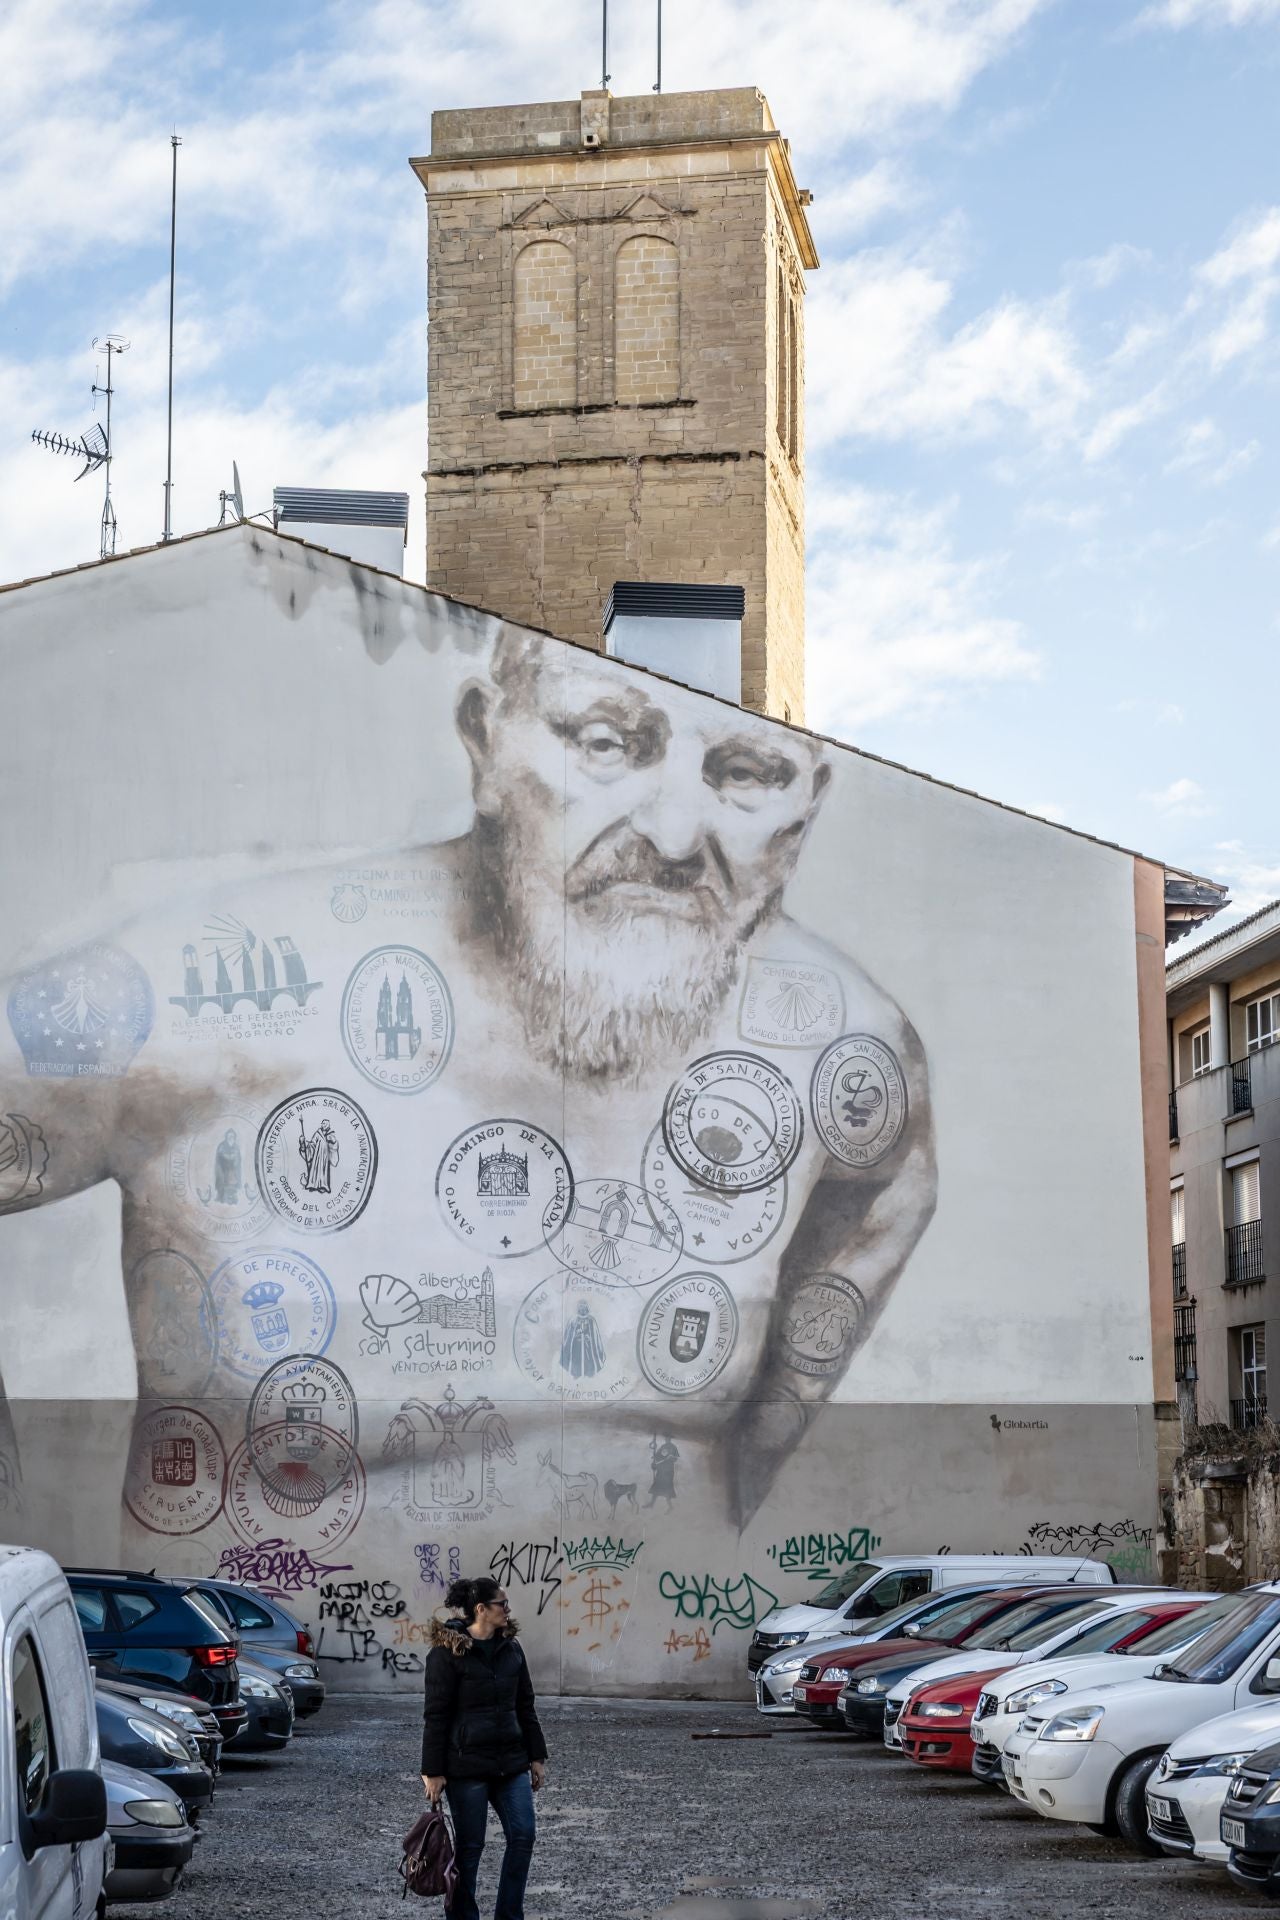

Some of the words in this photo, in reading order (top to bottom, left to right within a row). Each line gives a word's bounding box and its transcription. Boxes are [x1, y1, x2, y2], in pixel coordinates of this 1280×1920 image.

[762, 966, 797, 979] CENTRO
[798, 970, 830, 986] SOCIAL
[350, 981, 368, 1050] CONCATEDRAL
[431, 998, 444, 1041] REDONDA
[747, 1026, 778, 1040] AMIGOS
[835, 1050, 846, 1060] DE
[853, 1044, 870, 1054] SAN
[693, 1071, 709, 1086] DE
[716, 1063, 748, 1076] SAN
[518, 1129, 538, 1144] DE
[733, 1117, 753, 1136] DE
[265, 1118, 287, 1174] MONASTERIO
[286, 1109, 296, 1119] DE
[340, 1105, 351, 1116] DE
[350, 1117, 361, 1130] LA
[447, 1126, 505, 1174] DOMINGO
[539, 1142, 555, 1161] LA
[279, 1175, 300, 1204] ORDEN
[301, 1203, 321, 1212] DEL
[542, 1166, 565, 1230] CALZADA
[304, 1217, 314, 1226] DE
[325, 1198, 356, 1224] CALZADA
[445, 1186, 476, 1236] SANTO
[682, 1198, 720, 1217] AMIGOS
[686, 1210, 722, 1227] CAMINO
[243, 1261, 260, 1274] DE
[266, 1259, 323, 1325] PEREGRINOS
[418, 1272, 481, 1301] albergue
[648, 1281, 707, 1349] AYUNTAMIENTO
[715, 1337, 727, 1351] DE
[260, 1378, 280, 1416] EXCMO
[286, 1364, 347, 1412] AYUNTAMIENTO
[180, 1413, 192, 1429] de
[1004, 1419, 1049, 1430] Globartia
[311, 1437, 329, 1451] DE
[162, 1518, 173, 1527] DE
[433, 1511, 443, 1522] DE
